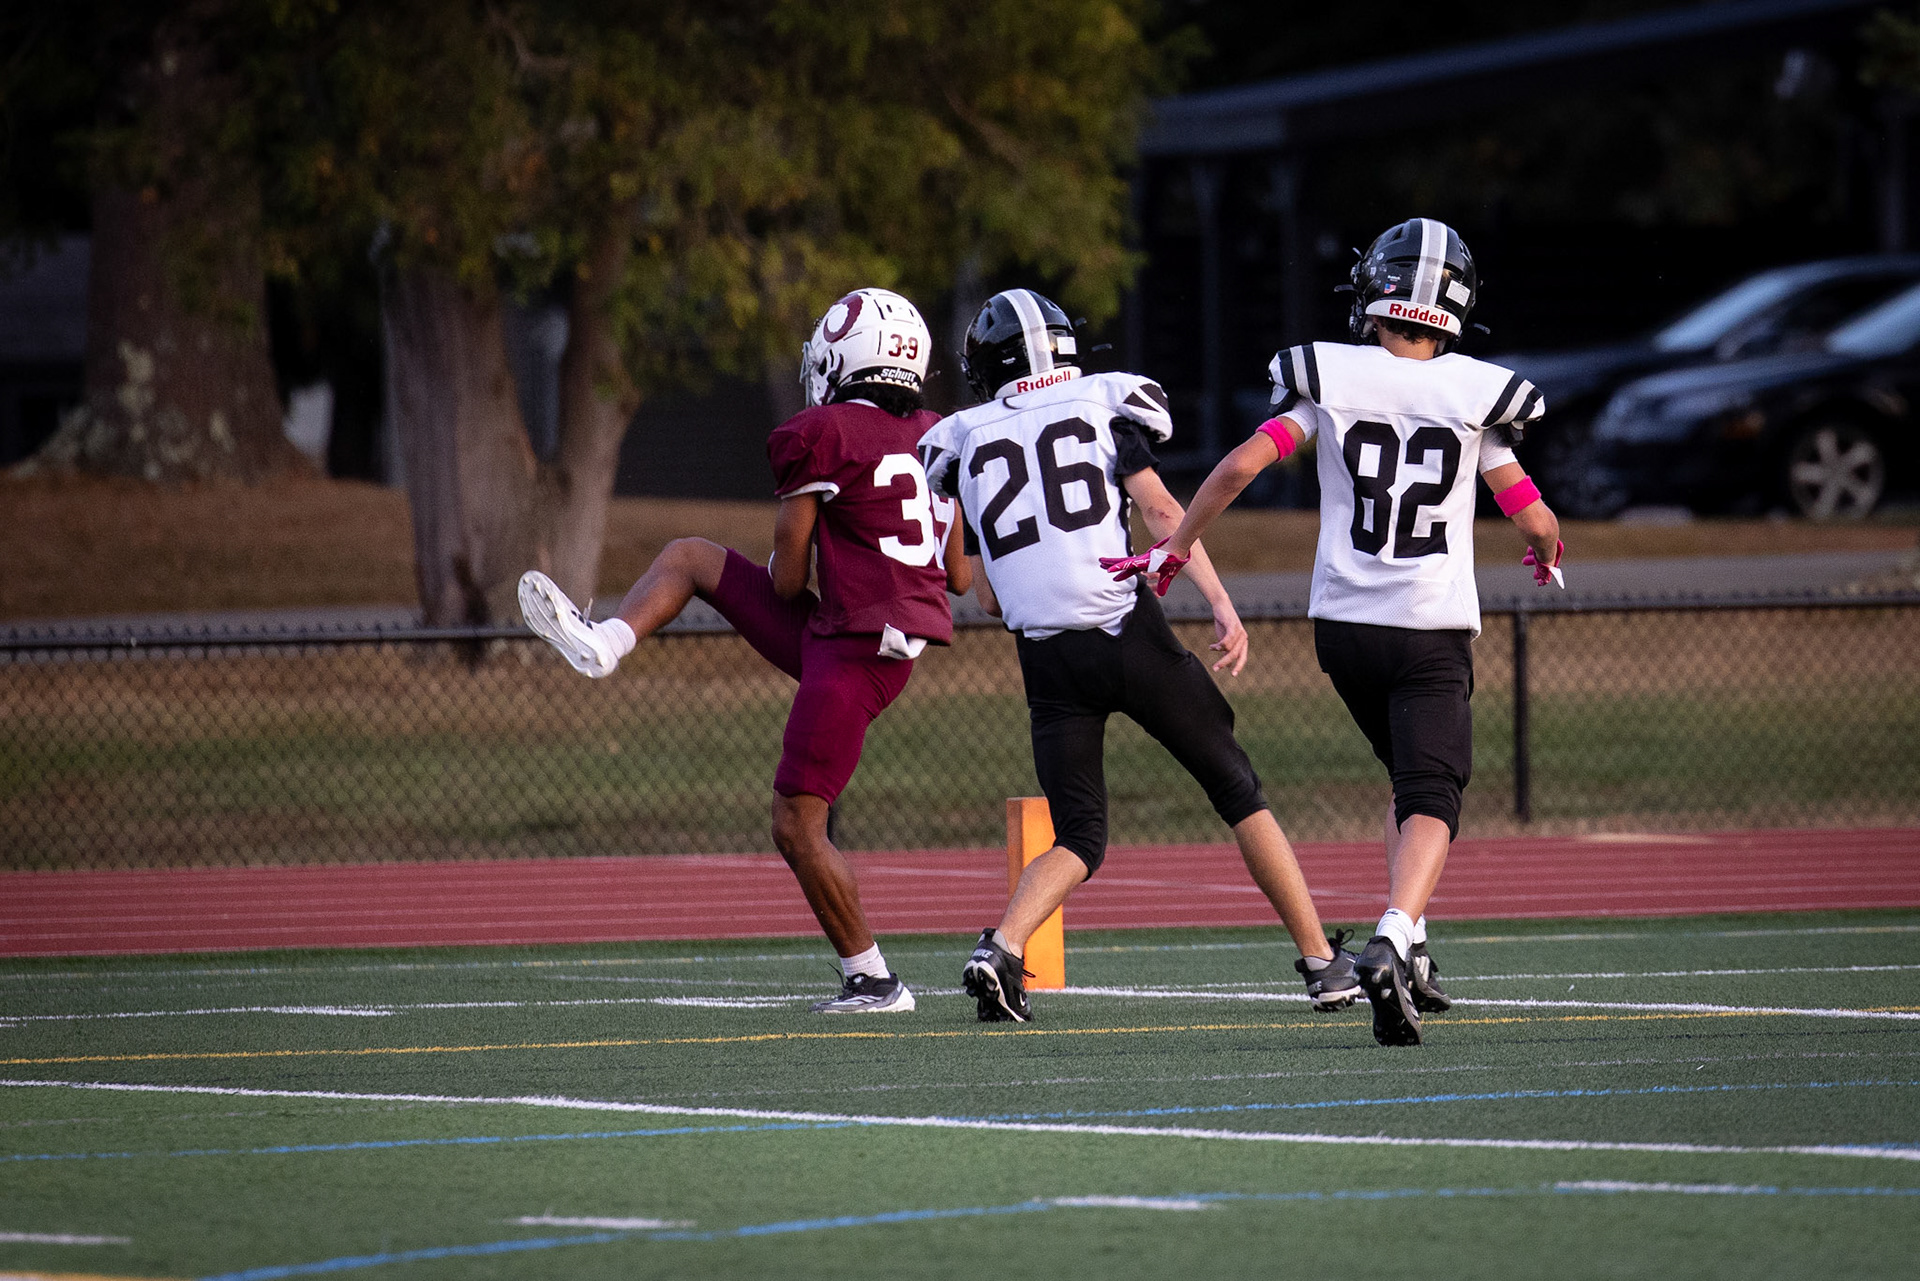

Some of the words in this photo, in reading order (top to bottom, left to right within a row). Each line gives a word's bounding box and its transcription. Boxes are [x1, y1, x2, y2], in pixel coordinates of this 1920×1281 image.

[1389, 303, 1450, 327] Riddell
[880, 367, 917, 382] schutt
[1017, 370, 1071, 393] Riddell
[968, 417, 1111, 561] 26
[1344, 420, 1462, 558] 82
